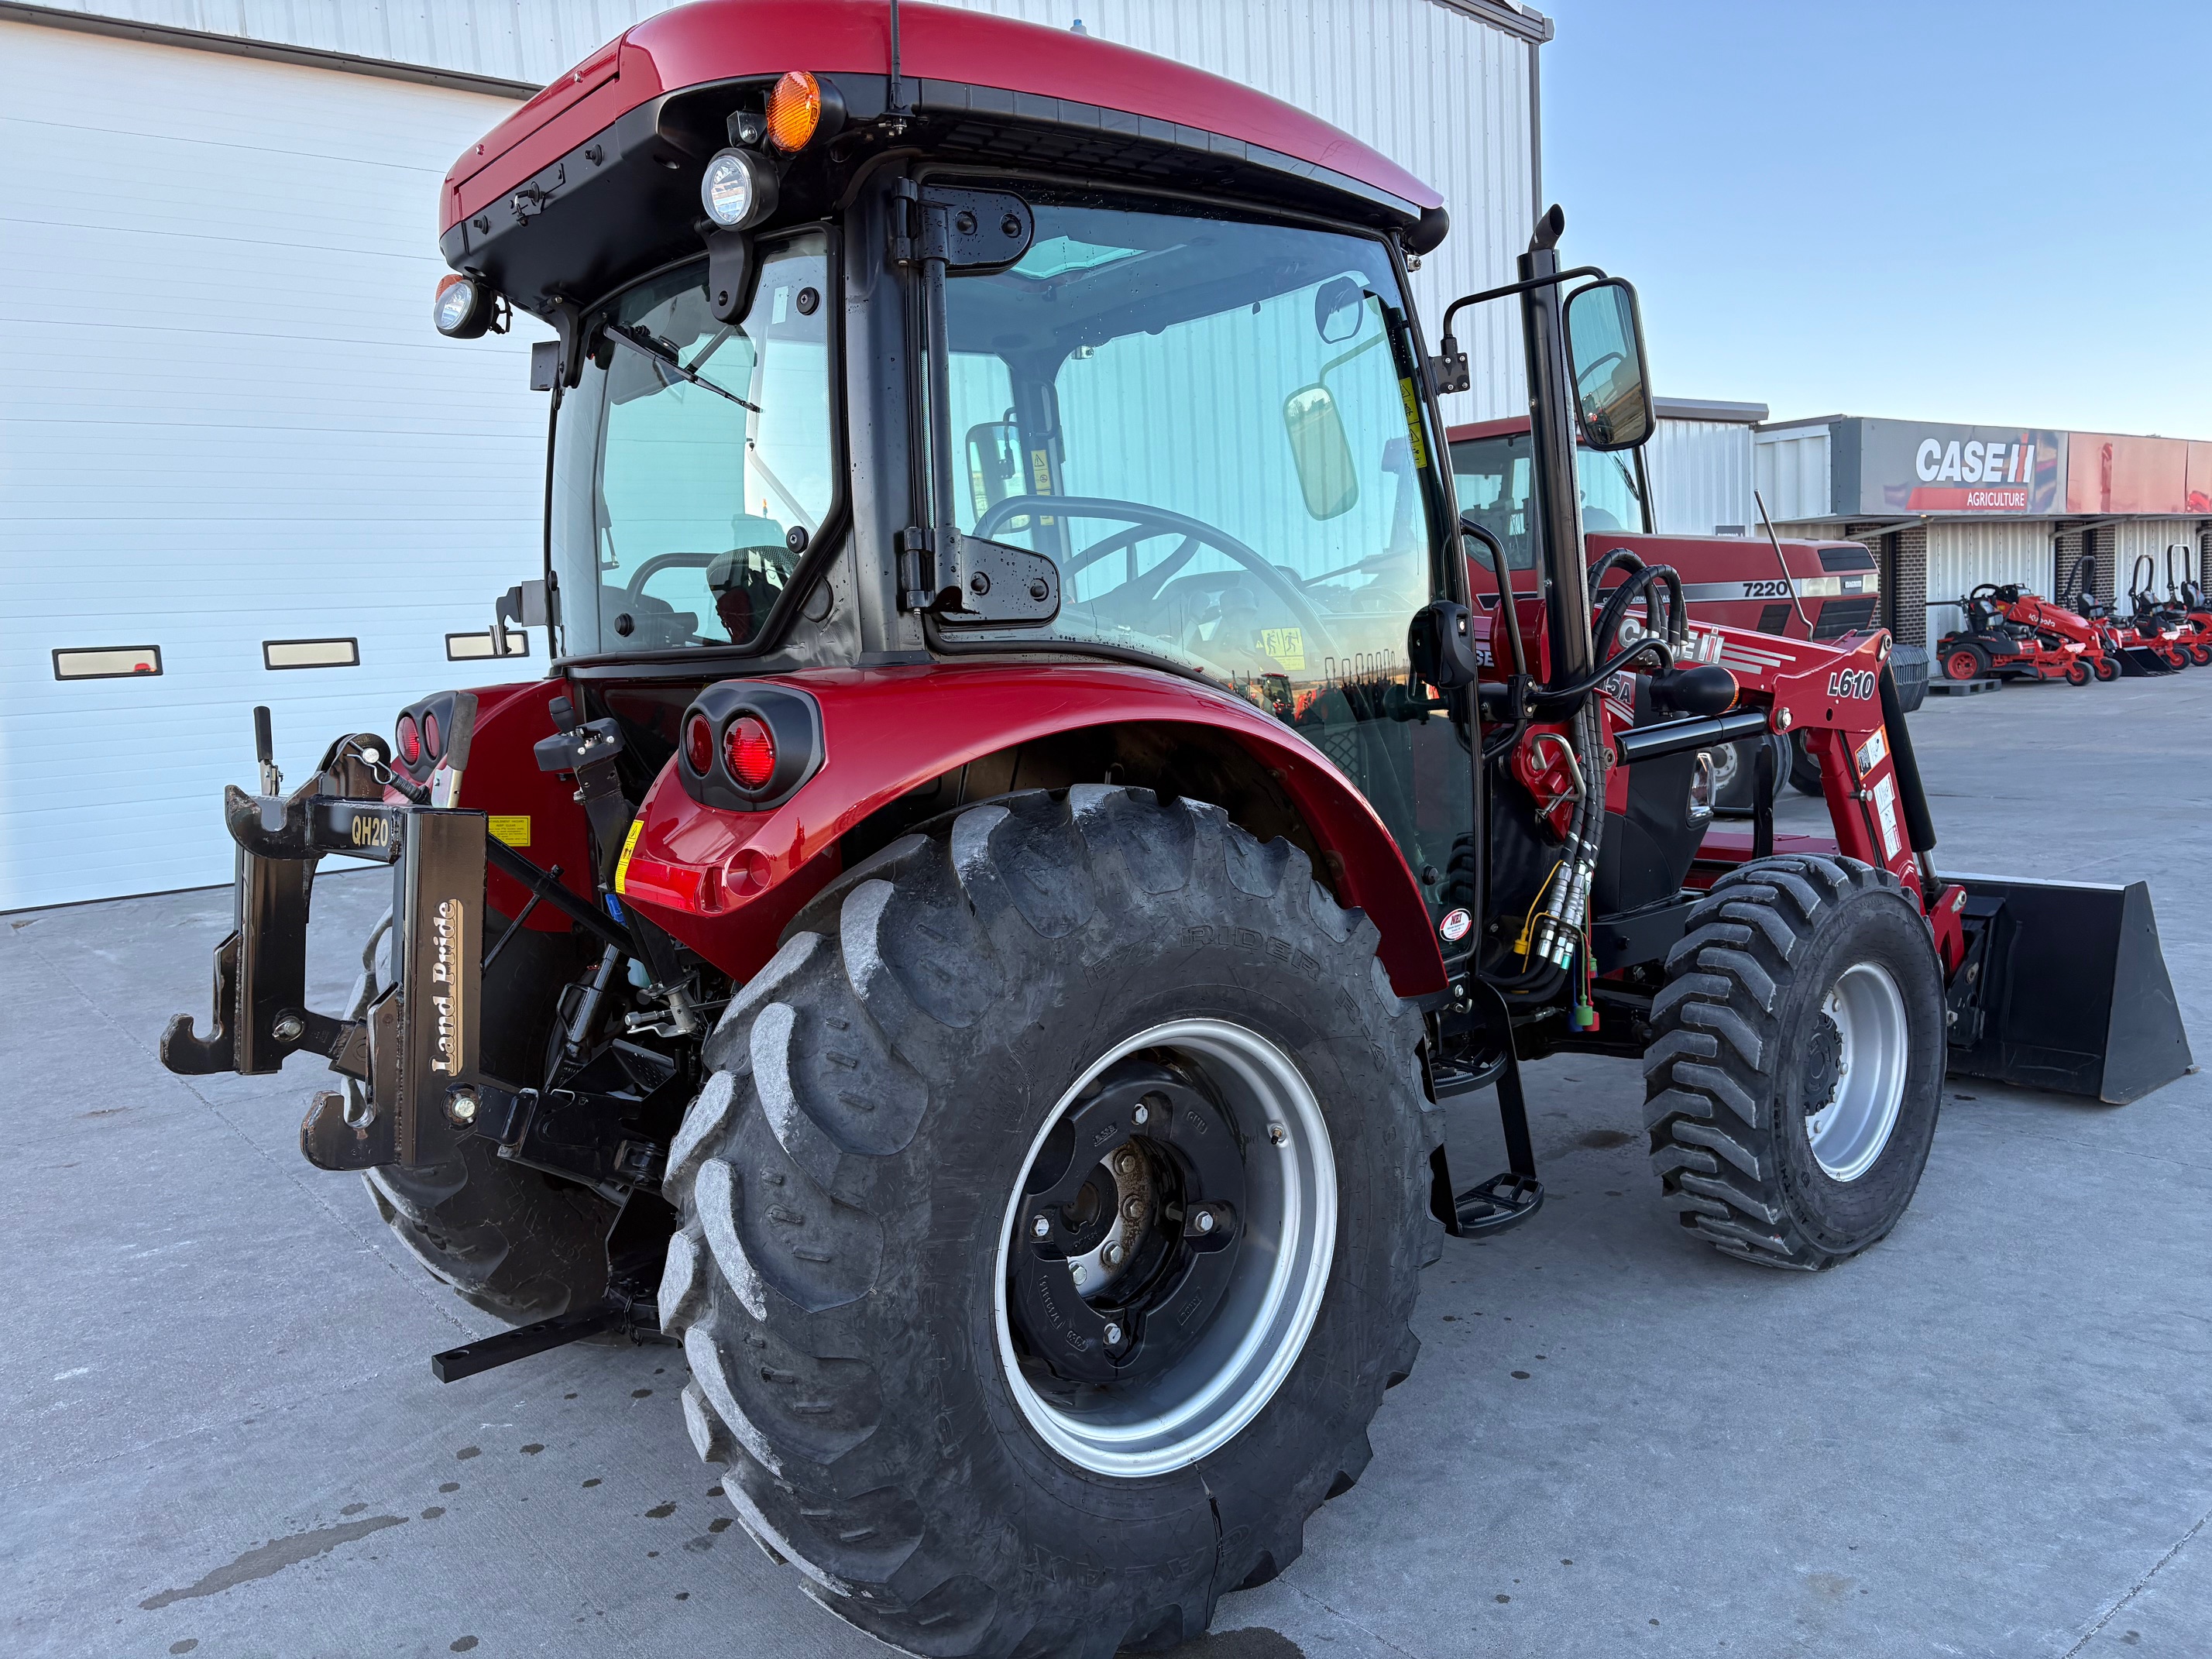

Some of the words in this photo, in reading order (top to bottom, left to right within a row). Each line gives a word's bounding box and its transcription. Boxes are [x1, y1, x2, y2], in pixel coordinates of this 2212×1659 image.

[1916, 438, 2006, 483] CASE
[1967, 493, 2025, 507] AGRICULTURE
[1743, 581, 1788, 597] 7220
[1603, 674, 1632, 705] 5A
[1827, 668, 1876, 701] L610
[352, 815, 389, 847] QH20
[432, 901, 455, 986] Pride
[1180, 924, 1321, 982] RIDER
[431, 995, 455, 1074] Land
